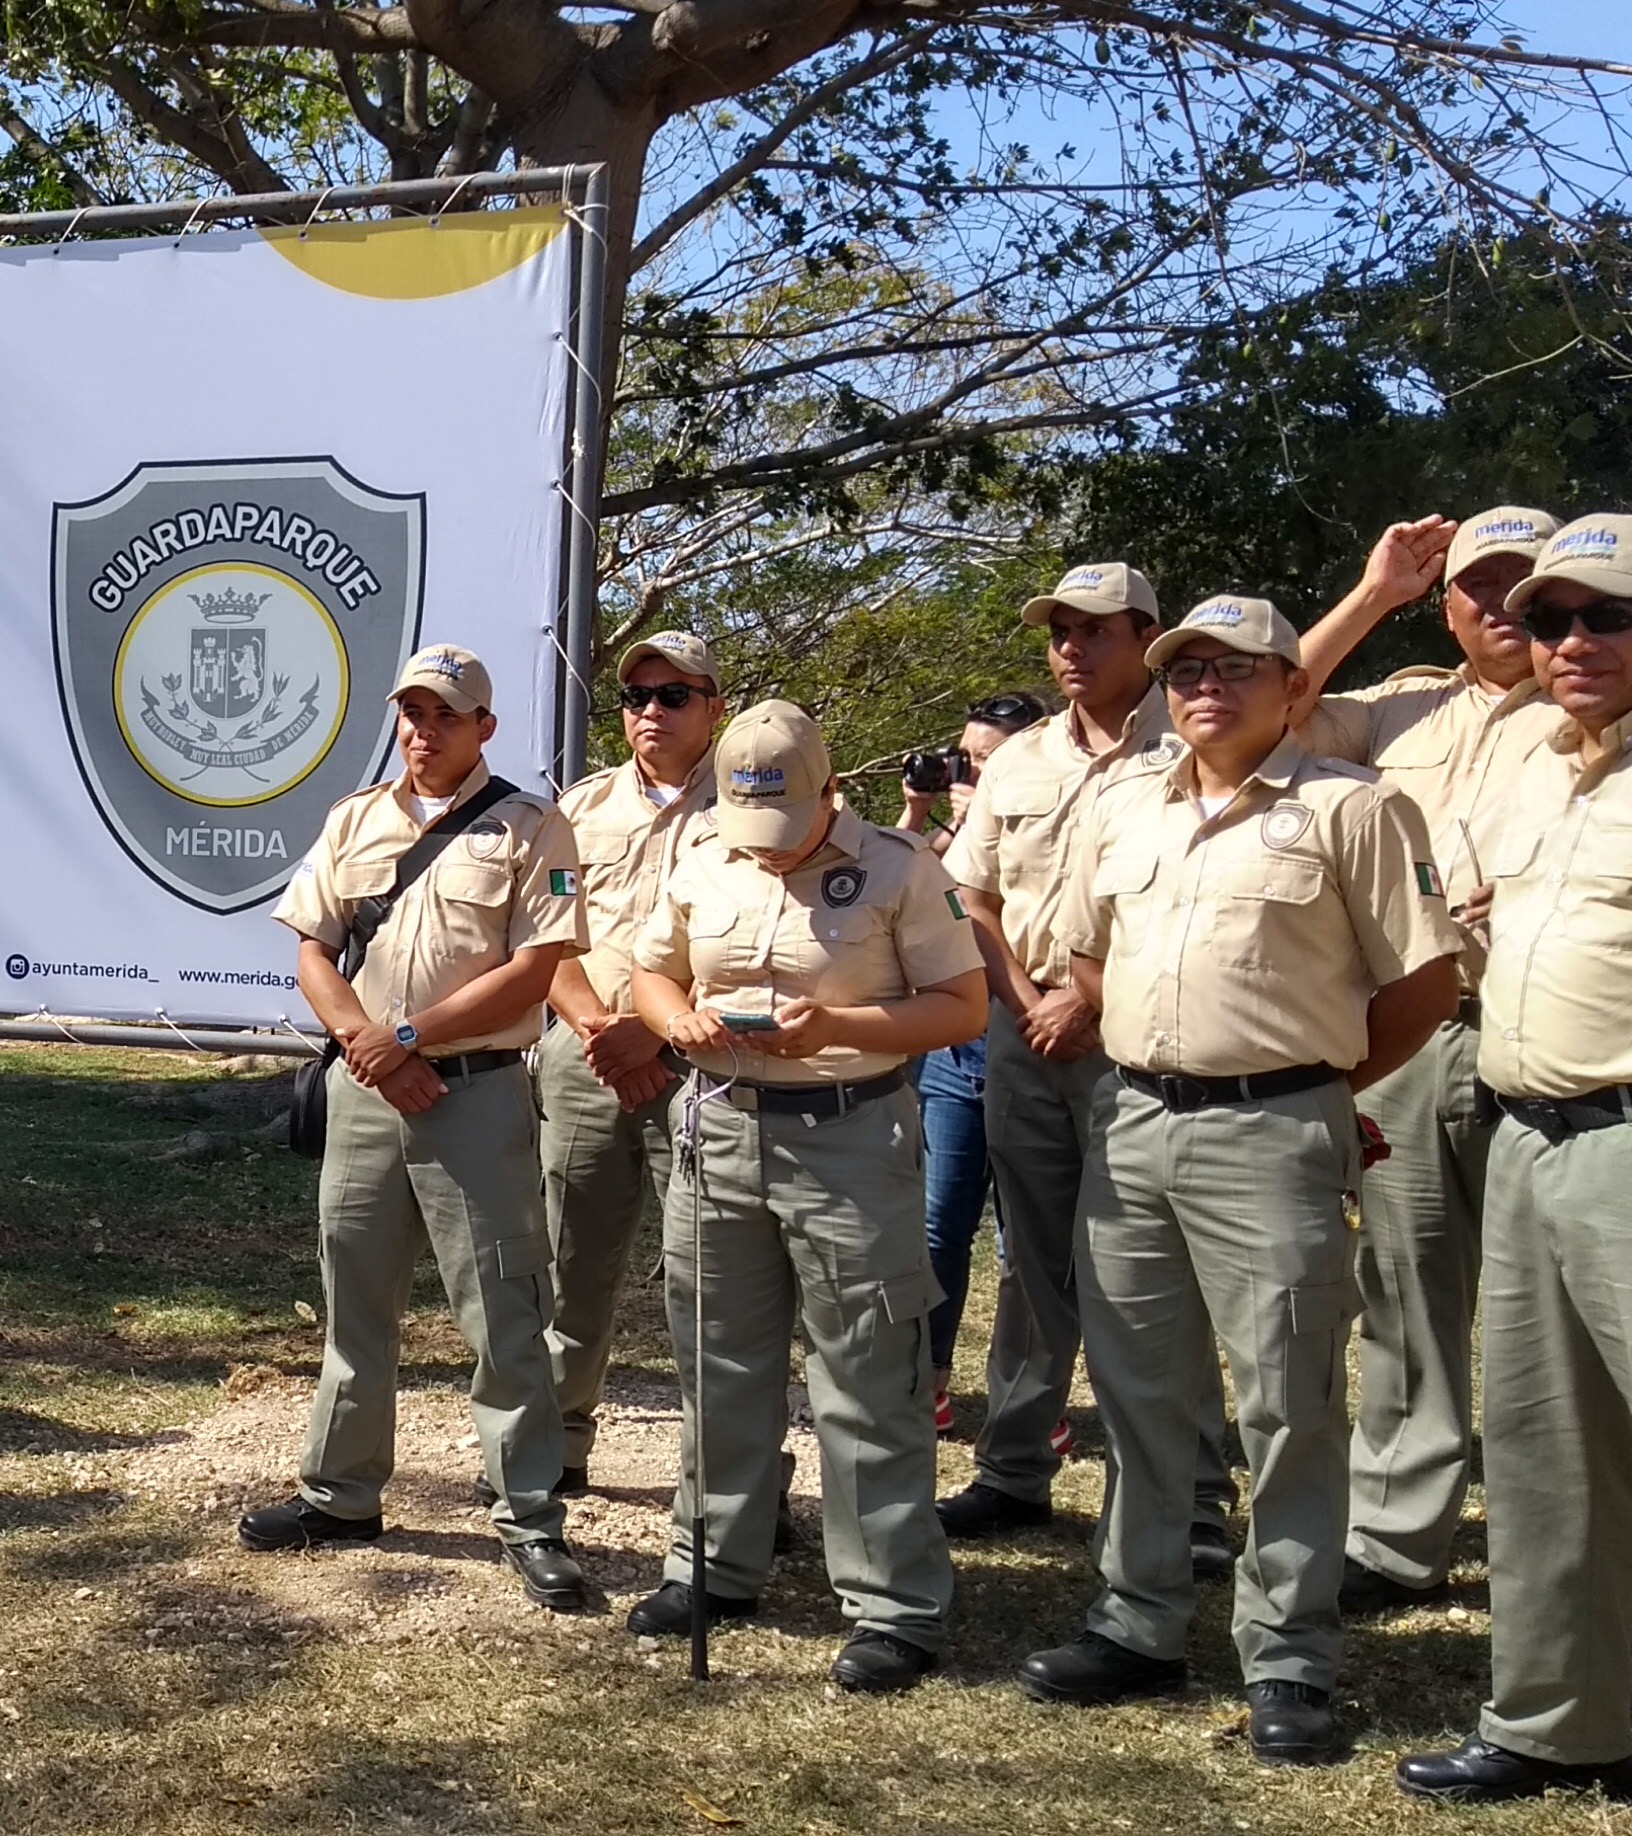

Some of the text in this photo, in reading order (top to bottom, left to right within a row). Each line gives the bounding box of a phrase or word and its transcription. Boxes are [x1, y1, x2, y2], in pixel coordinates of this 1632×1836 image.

[90, 503, 380, 612] GUARDAPARQUE
[271, 737, 284, 751] DE
[190, 748, 267, 766] MUY LEAL CIUDAD
[166, 820, 288, 859] MÉRIDA
[32, 961, 160, 983] ayuntamerida_
